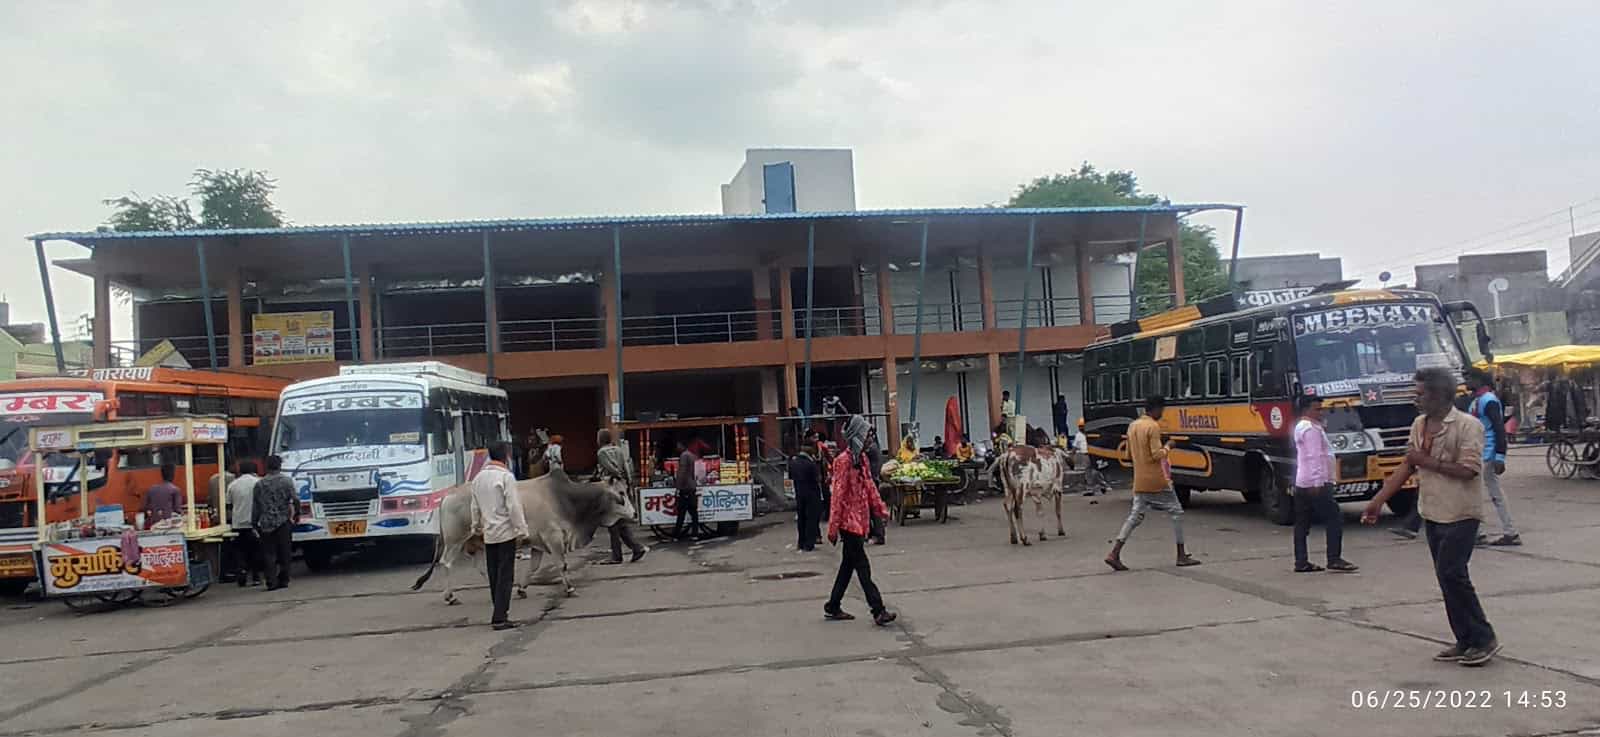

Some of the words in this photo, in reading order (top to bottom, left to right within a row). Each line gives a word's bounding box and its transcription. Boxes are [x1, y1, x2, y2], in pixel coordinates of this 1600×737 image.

[1304, 305, 1432, 335] MEENAXI
[0, 394, 90, 412] म्बर
[300, 395, 404, 412] अम्बर
[1178, 407, 1220, 430] Meenaxi
